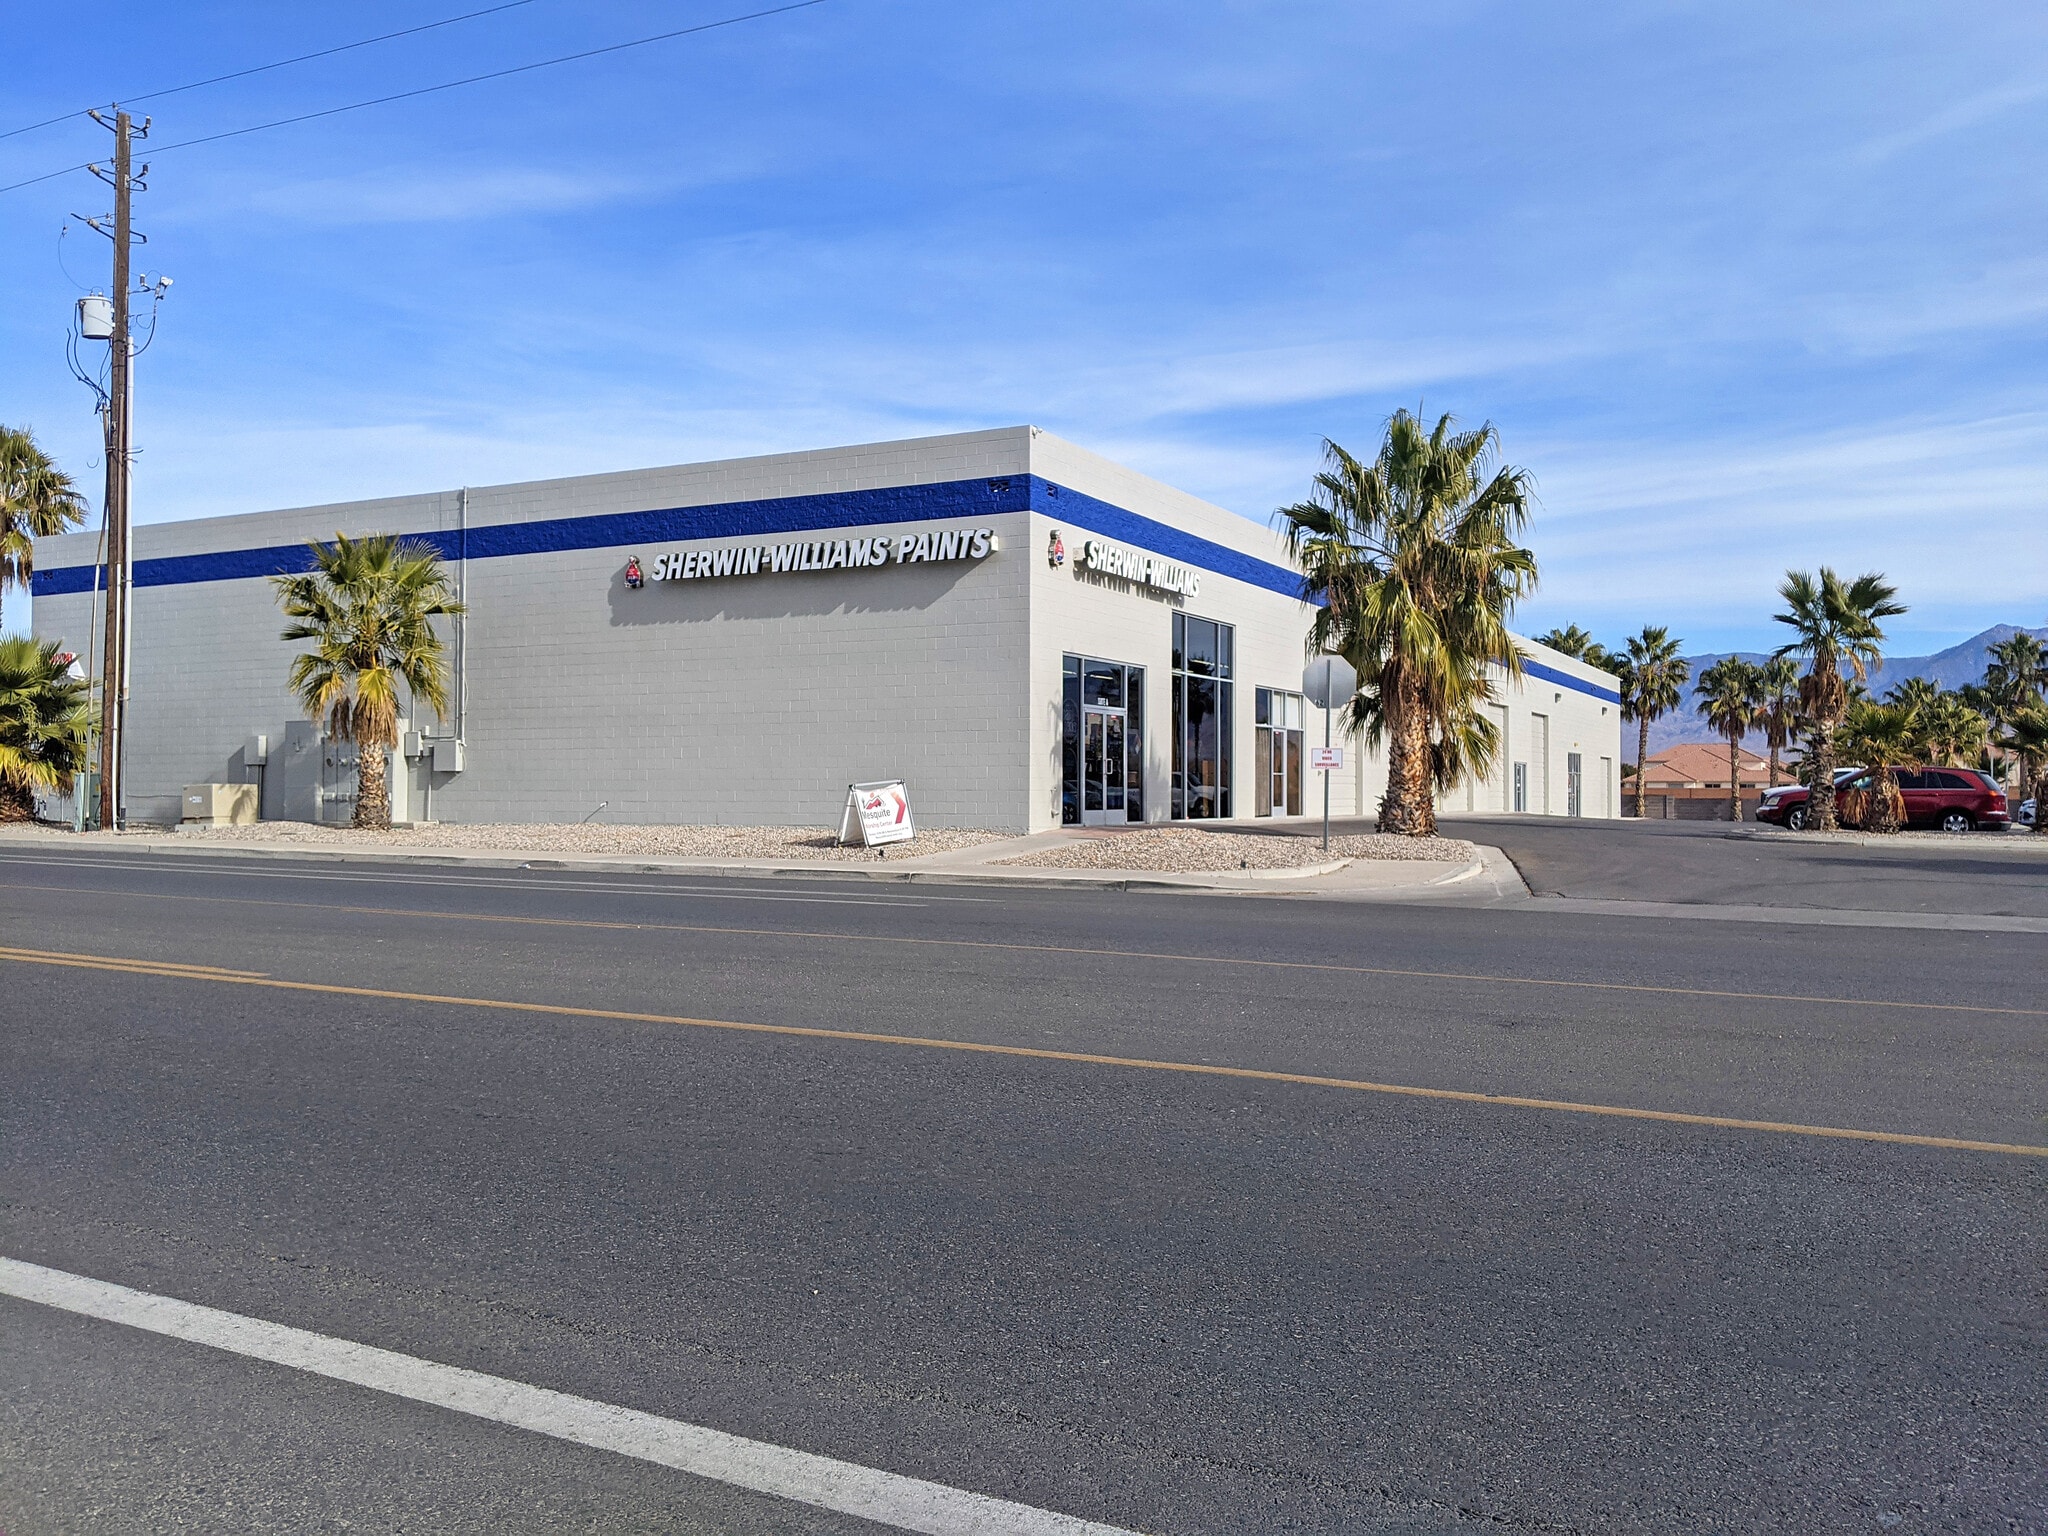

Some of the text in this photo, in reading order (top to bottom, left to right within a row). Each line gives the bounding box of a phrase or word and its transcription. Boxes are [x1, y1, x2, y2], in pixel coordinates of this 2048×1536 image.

[652, 529, 994, 582] SHERWIN-WILLIAMS PAINTS
[1085, 540, 1200, 598] SHERWIN-WILLIAMS
[861, 809, 891, 820] Mesquite
